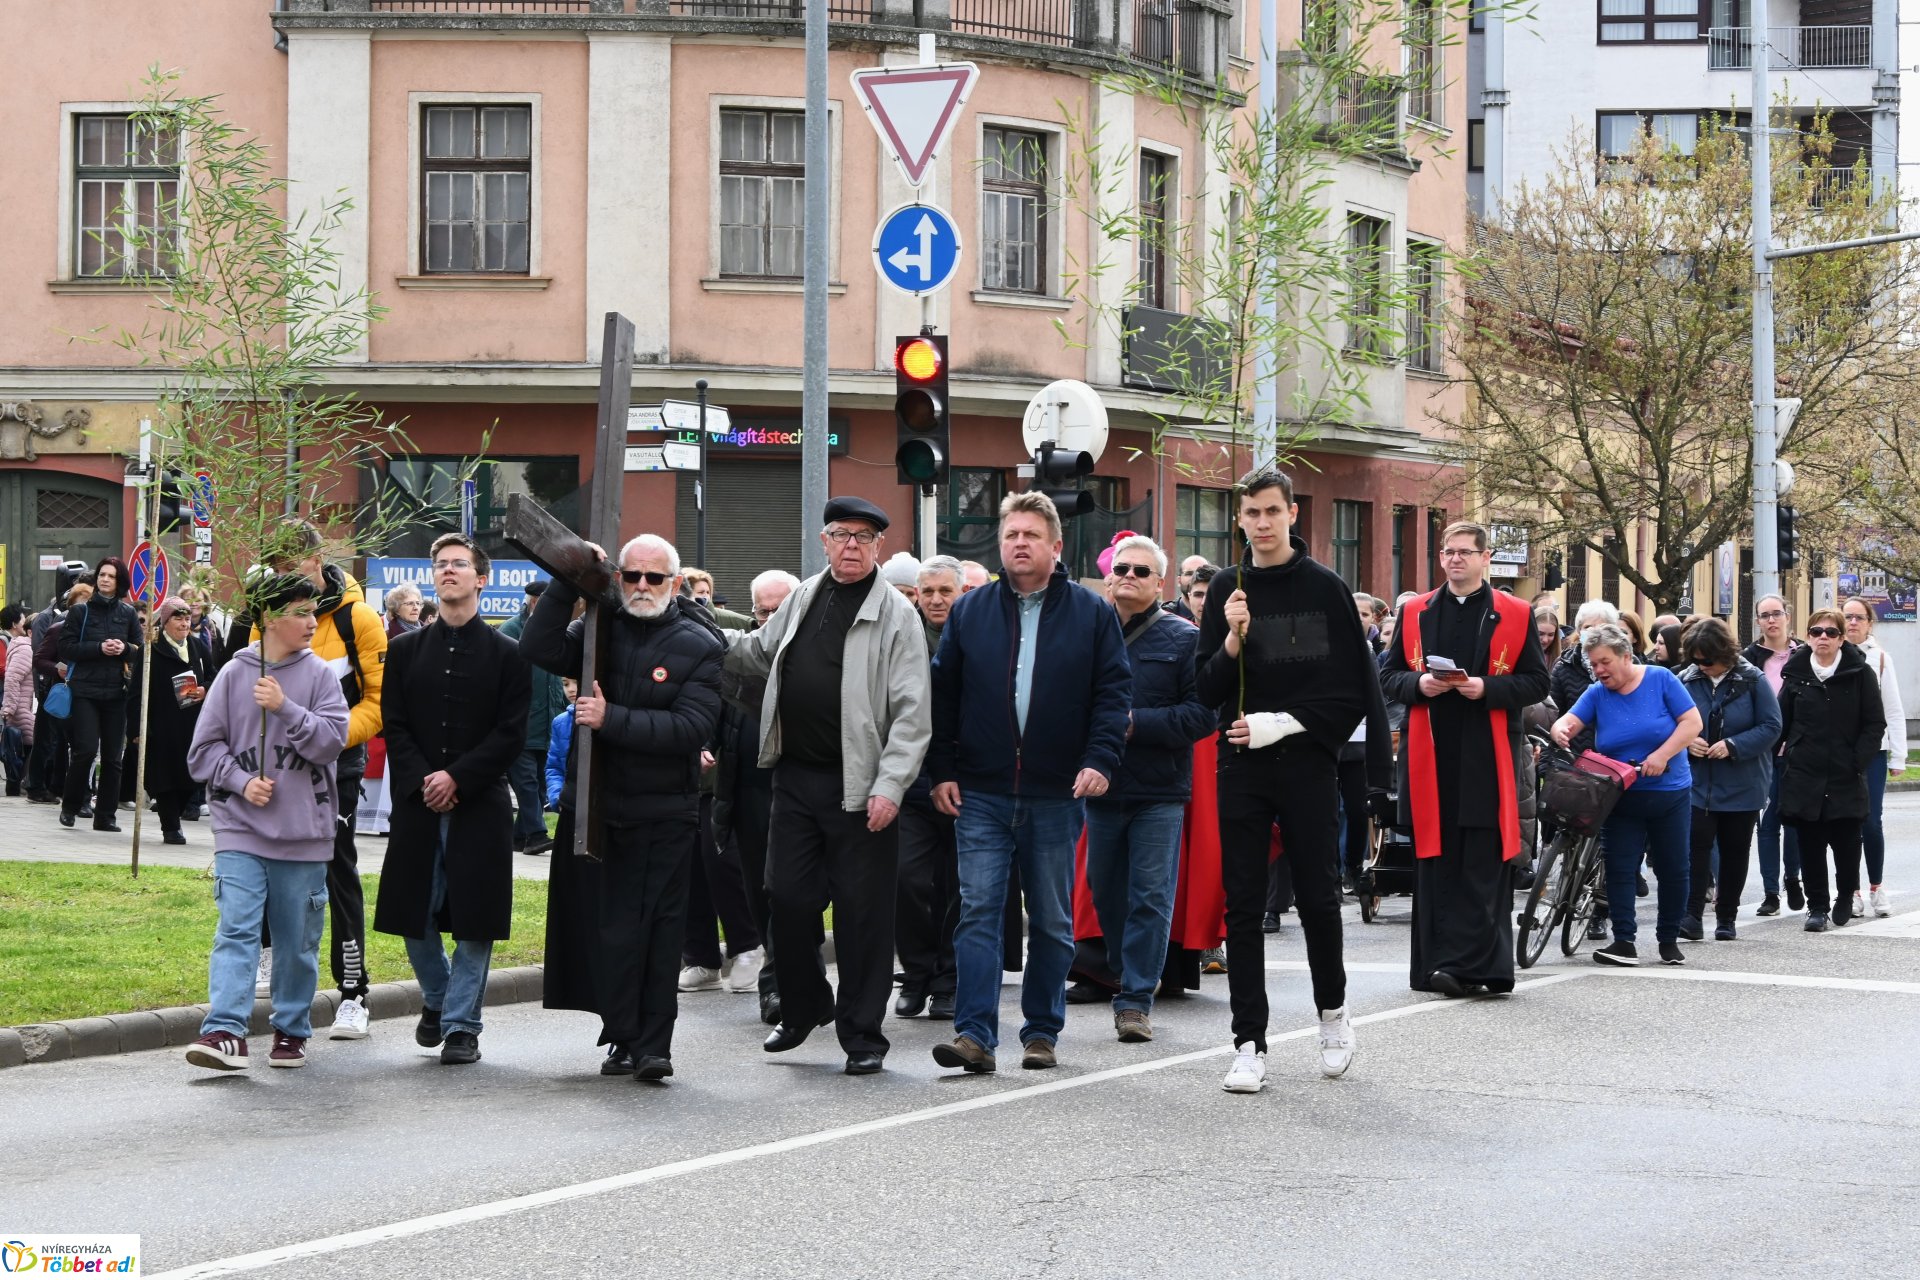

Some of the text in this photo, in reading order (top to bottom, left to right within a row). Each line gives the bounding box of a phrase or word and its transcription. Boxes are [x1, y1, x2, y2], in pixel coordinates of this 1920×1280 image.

[678, 427, 838, 447] LE világítástecha
[500, 569, 537, 587] BOLT
[480, 597, 520, 613] ORZS
[342, 939, 362, 989] PUMA
